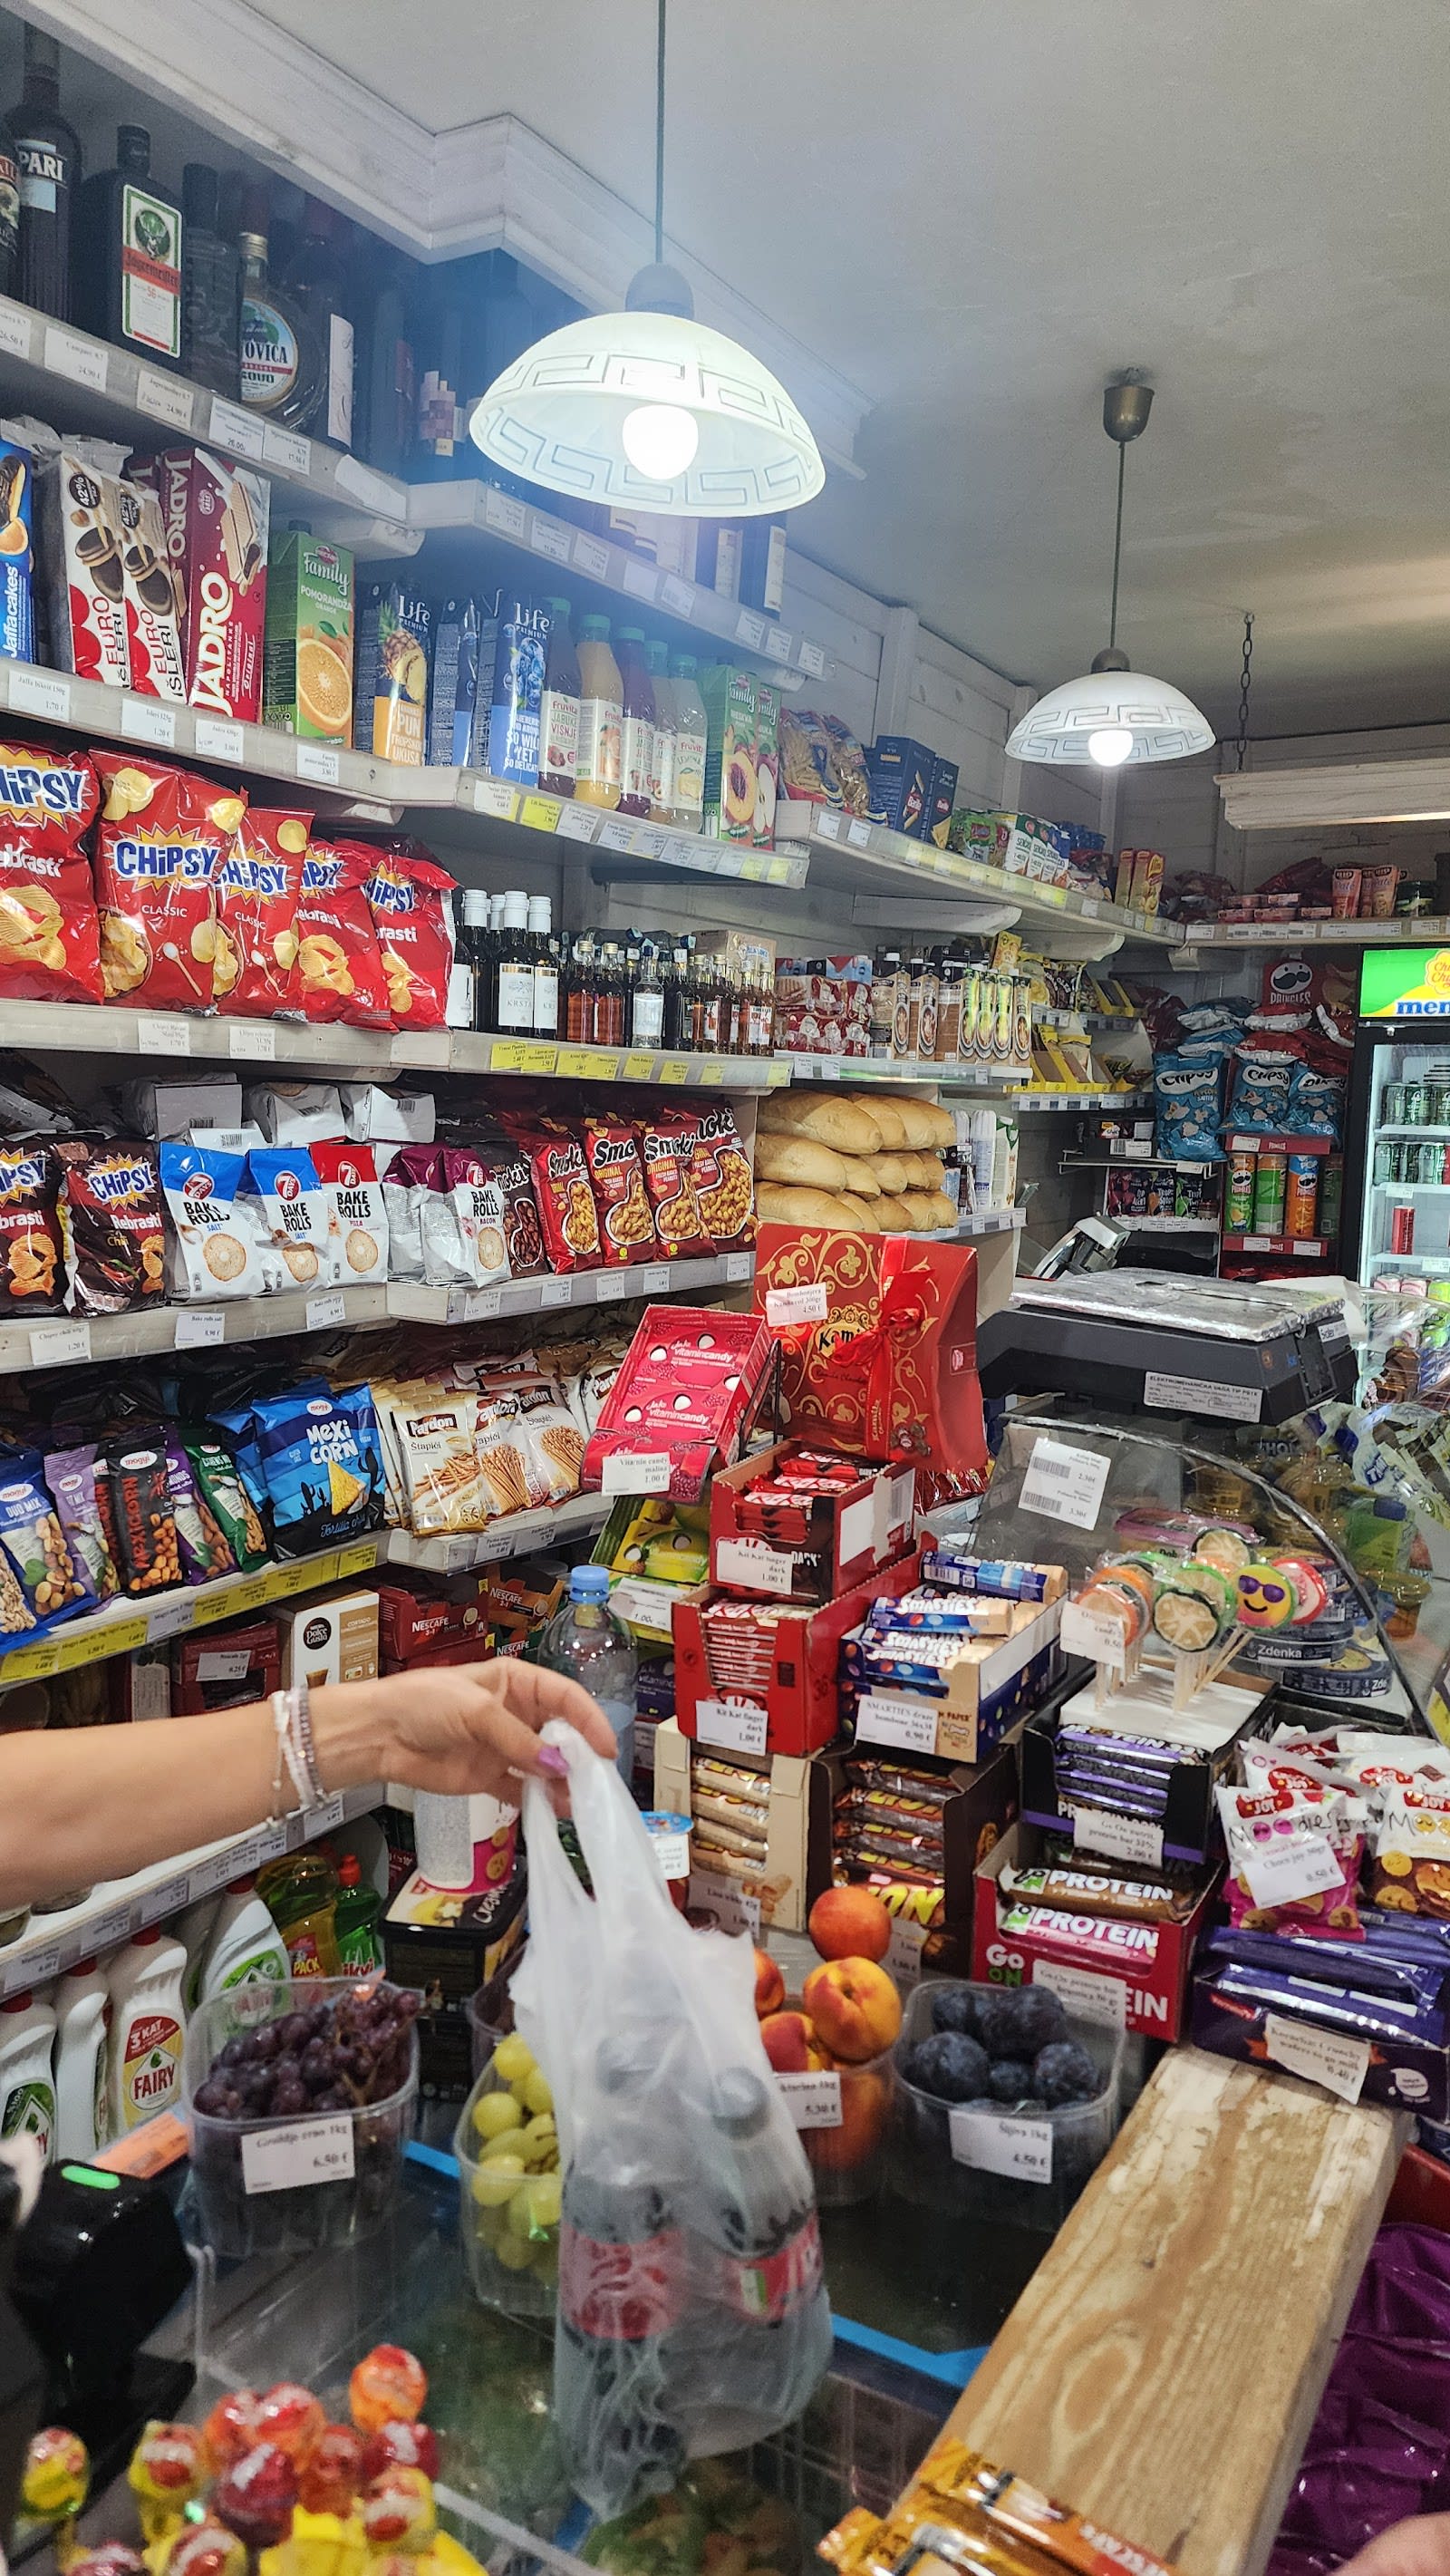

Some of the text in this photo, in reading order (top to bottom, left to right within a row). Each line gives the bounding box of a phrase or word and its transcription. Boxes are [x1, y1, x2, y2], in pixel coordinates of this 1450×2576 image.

[165, 456, 192, 559] JADRO
[303, 552, 351, 595] Family
[398, 595, 430, 625] Life
[515, 602, 550, 633] Life
[92, 596, 119, 666] EURO
[140, 609, 168, 675] EURO
[188, 571, 234, 717] JADRO
[515, 759, 539, 774] DELICAT
[141, 904, 188, 918] CLASSIC
[234, 911, 266, 930] CLASSIC
[1270, 991, 1311, 1005] PRINGLES
[643, 1131, 696, 1162] Smoki
[646, 1159, 677, 1175] ORIGINAL
[348, 1167, 361, 1188] DAYS
[285, 1176, 299, 1199] DAYS
[471, 1190, 496, 1203] BAKE
[336, 1191, 369, 1206] BAKE
[279, 1203, 308, 1218] BAKE
[339, 1204, 372, 1219] ROLLS
[473, 1202, 499, 1216] ROLLS
[112, 1212, 162, 1230] Rebrasti
[206, 1224, 222, 1233] SALT
[284, 1216, 312, 1233] ROLLS
[674, 1347, 735, 1363] vitamincandy
[649, 1409, 711, 1425] vitamincandy
[410, 1416, 454, 1438] Pardon
[124, 1453, 152, 1468] mogyi
[309, 1438, 359, 1465] CORN
[644, 1466, 668, 1474] malina
[5, 1498, 43, 1518] DUO MIX
[895, 1597, 978, 1614] SMARTIES
[882, 1631, 965, 1656] SMARTIES
[1258, 1643, 1302, 1659] Zdenka
[746, 1723, 763, 1733] dark
[1049, 1869, 1174, 1901] PROTEIN
[1031, 1907, 1159, 1951] PROTEIN
[986, 1943, 1024, 1970] Go
[292, 1956, 320, 1977] PACK
[129, 2019, 163, 2049] 3 KAT
[133, 2064, 176, 2100] FAIRY
